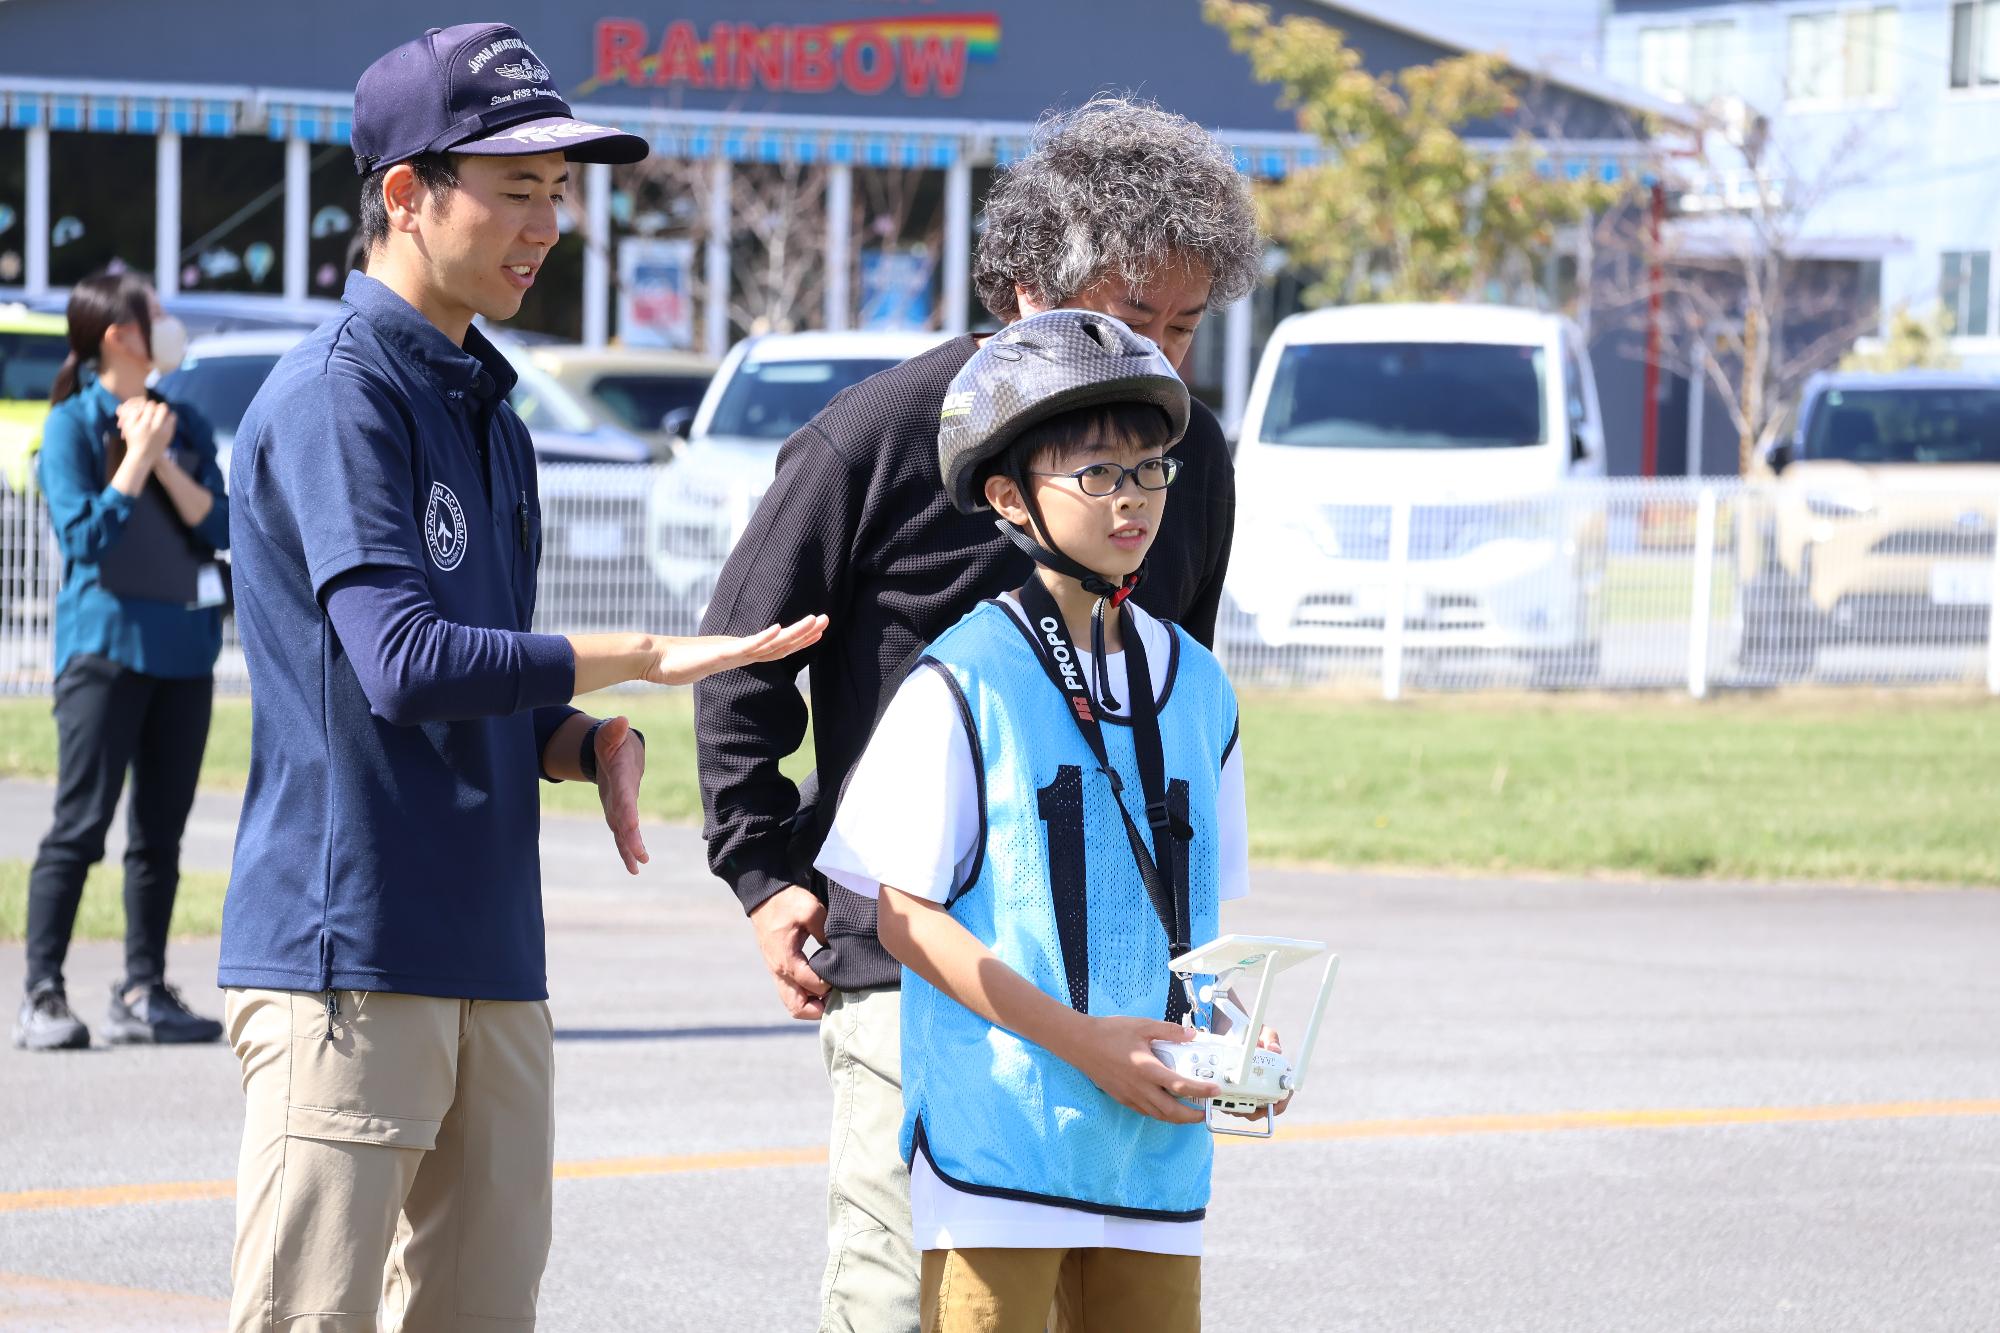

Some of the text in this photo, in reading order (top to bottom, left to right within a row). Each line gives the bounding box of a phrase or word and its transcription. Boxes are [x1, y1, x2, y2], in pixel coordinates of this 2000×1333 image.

[468, 38, 525, 74] JAPAN AVIATION
[594, 17, 969, 98] RAINBOW
[427, 509, 438, 547] JAPAN
[444, 493, 466, 548] ACADEMY
[1040, 616, 1083, 690] PROPO
